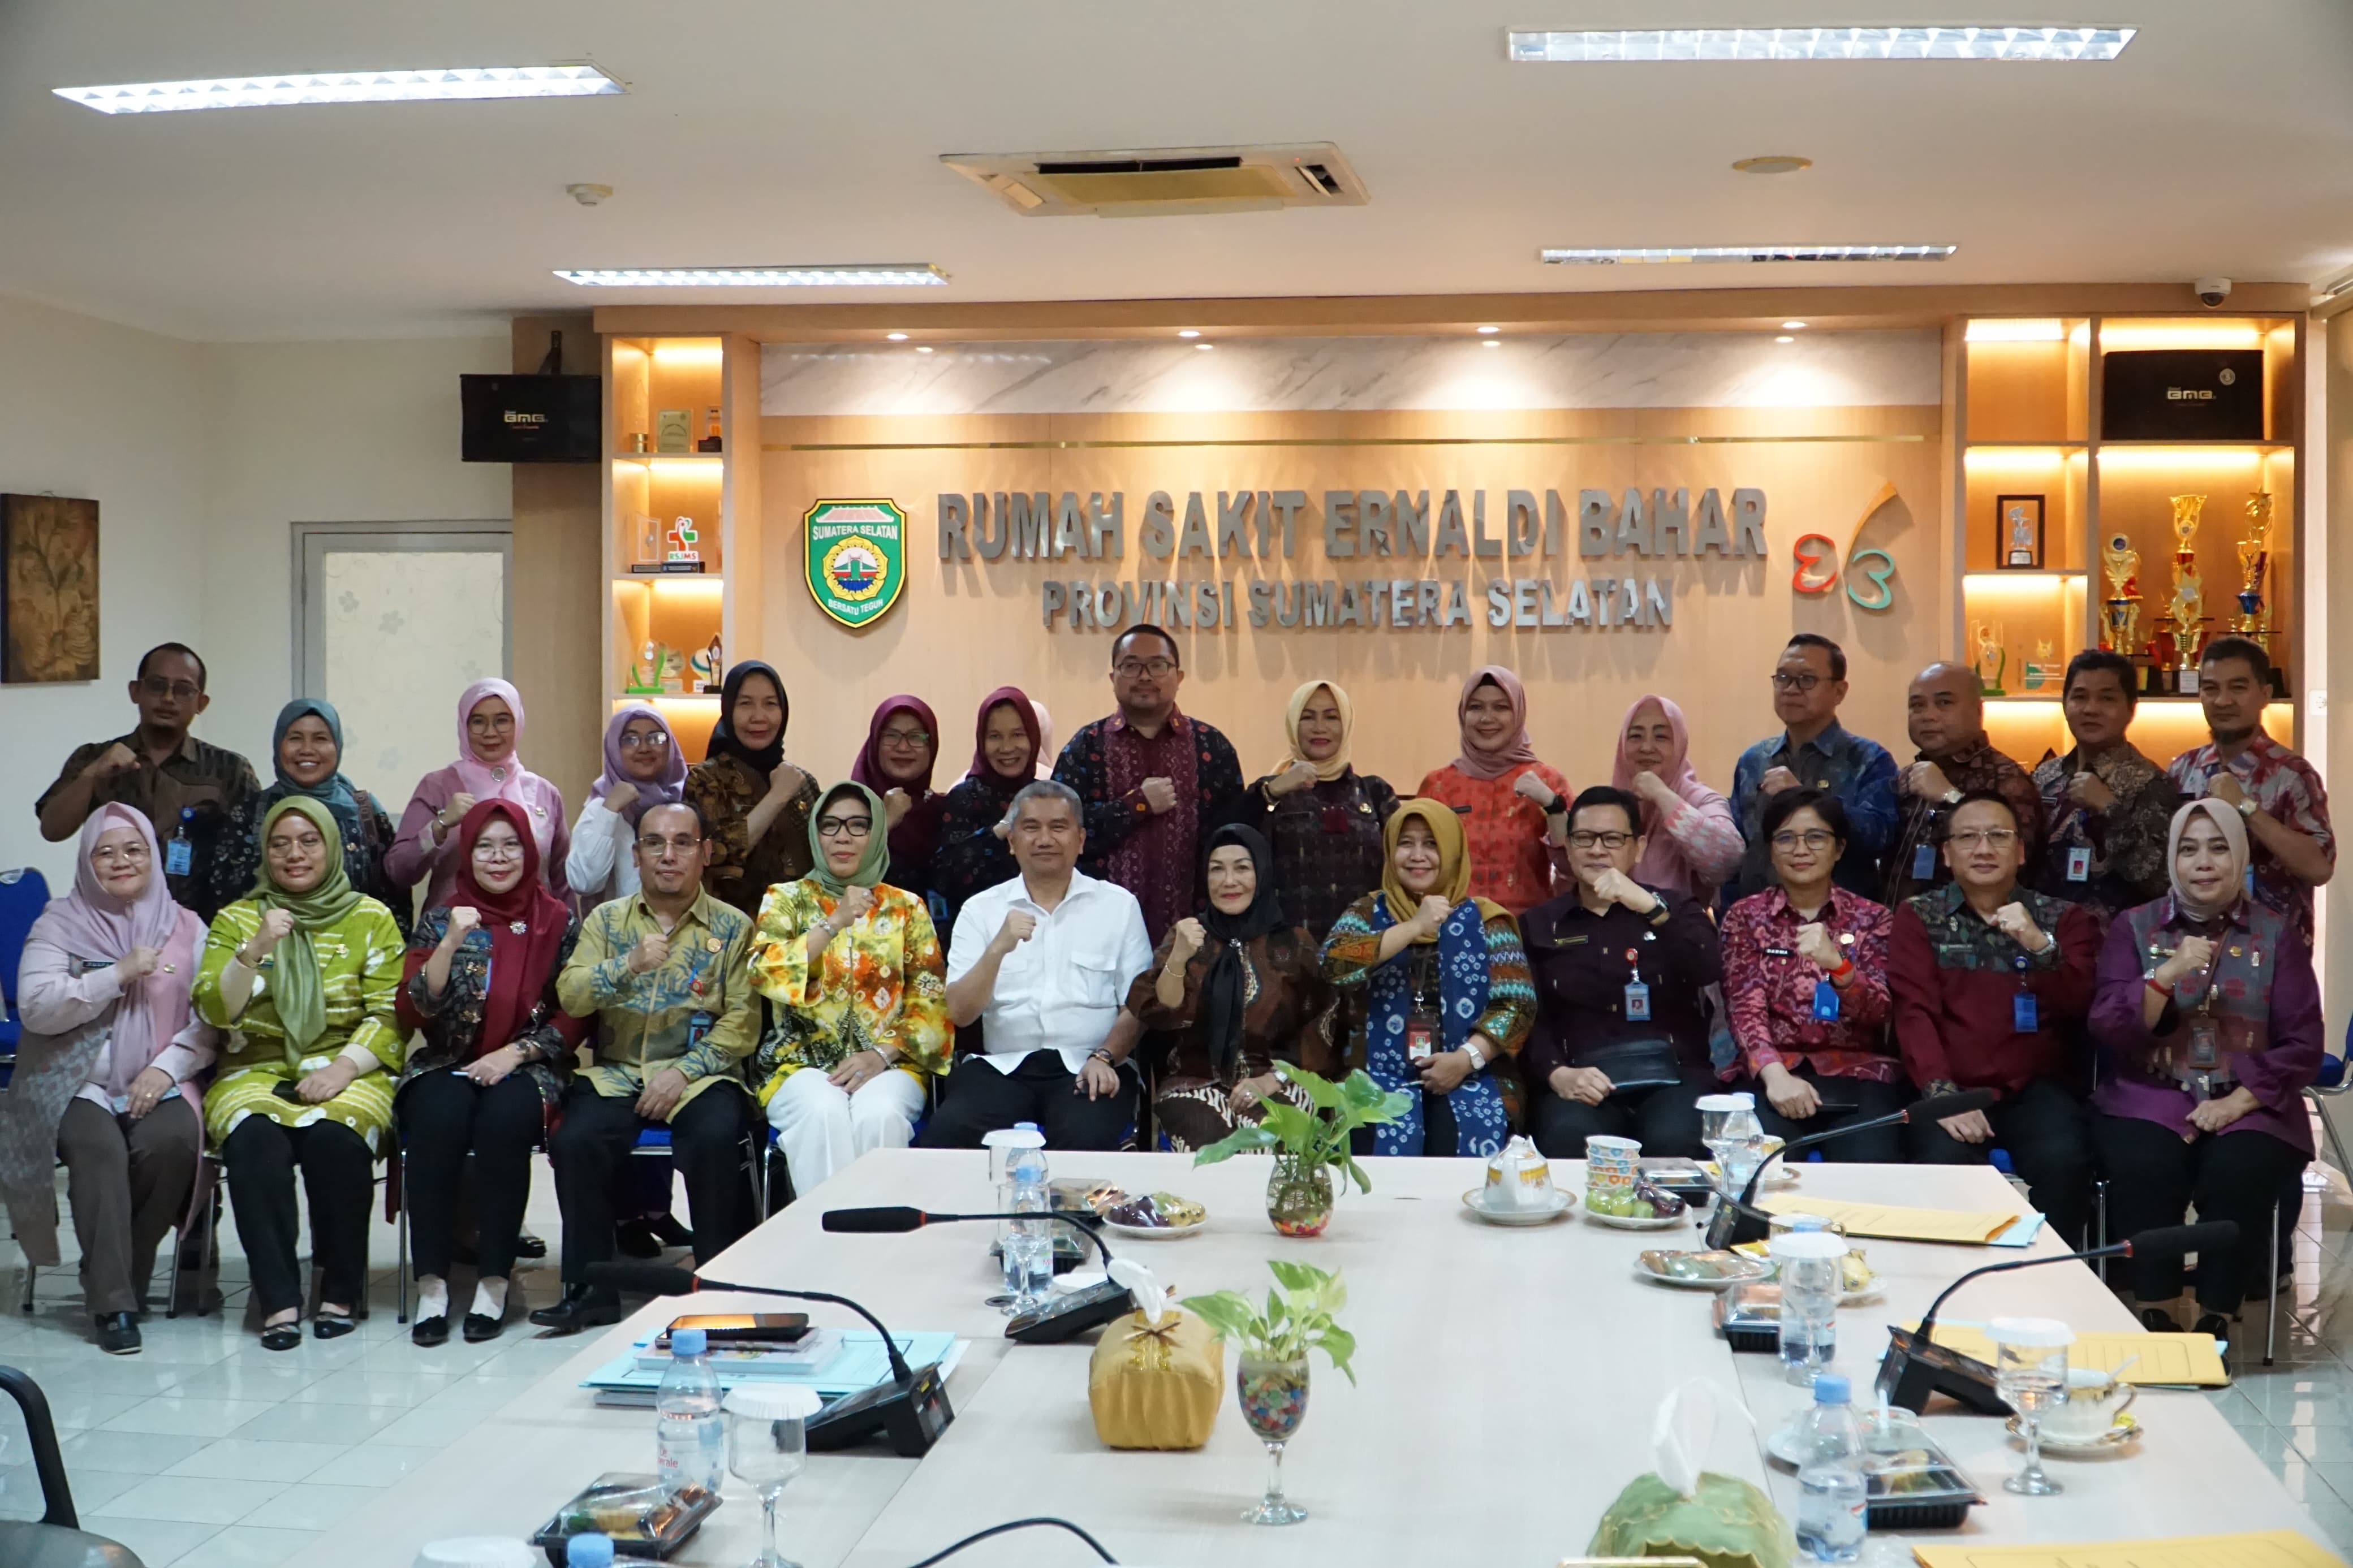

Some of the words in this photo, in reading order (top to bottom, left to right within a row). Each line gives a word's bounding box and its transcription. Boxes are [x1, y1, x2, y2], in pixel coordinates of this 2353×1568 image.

[813, 525, 859, 540] SUMATERA
[860, 525, 898, 540] SELATAN
[938, 491, 1123, 559] RUMAH
[1143, 490, 1304, 558] SAKIT
[1325, 489, 1557, 557] ERNALDI
[1581, 487, 1766, 556] BAHAR
[828, 599, 859, 615] BERSATU
[861, 599, 883, 612] TEGUH
[1043, 580, 1232, 629] PROVINSI
[1248, 580, 1471, 628] SUMATERA
[1488, 578, 1673, 627] SELATAN
